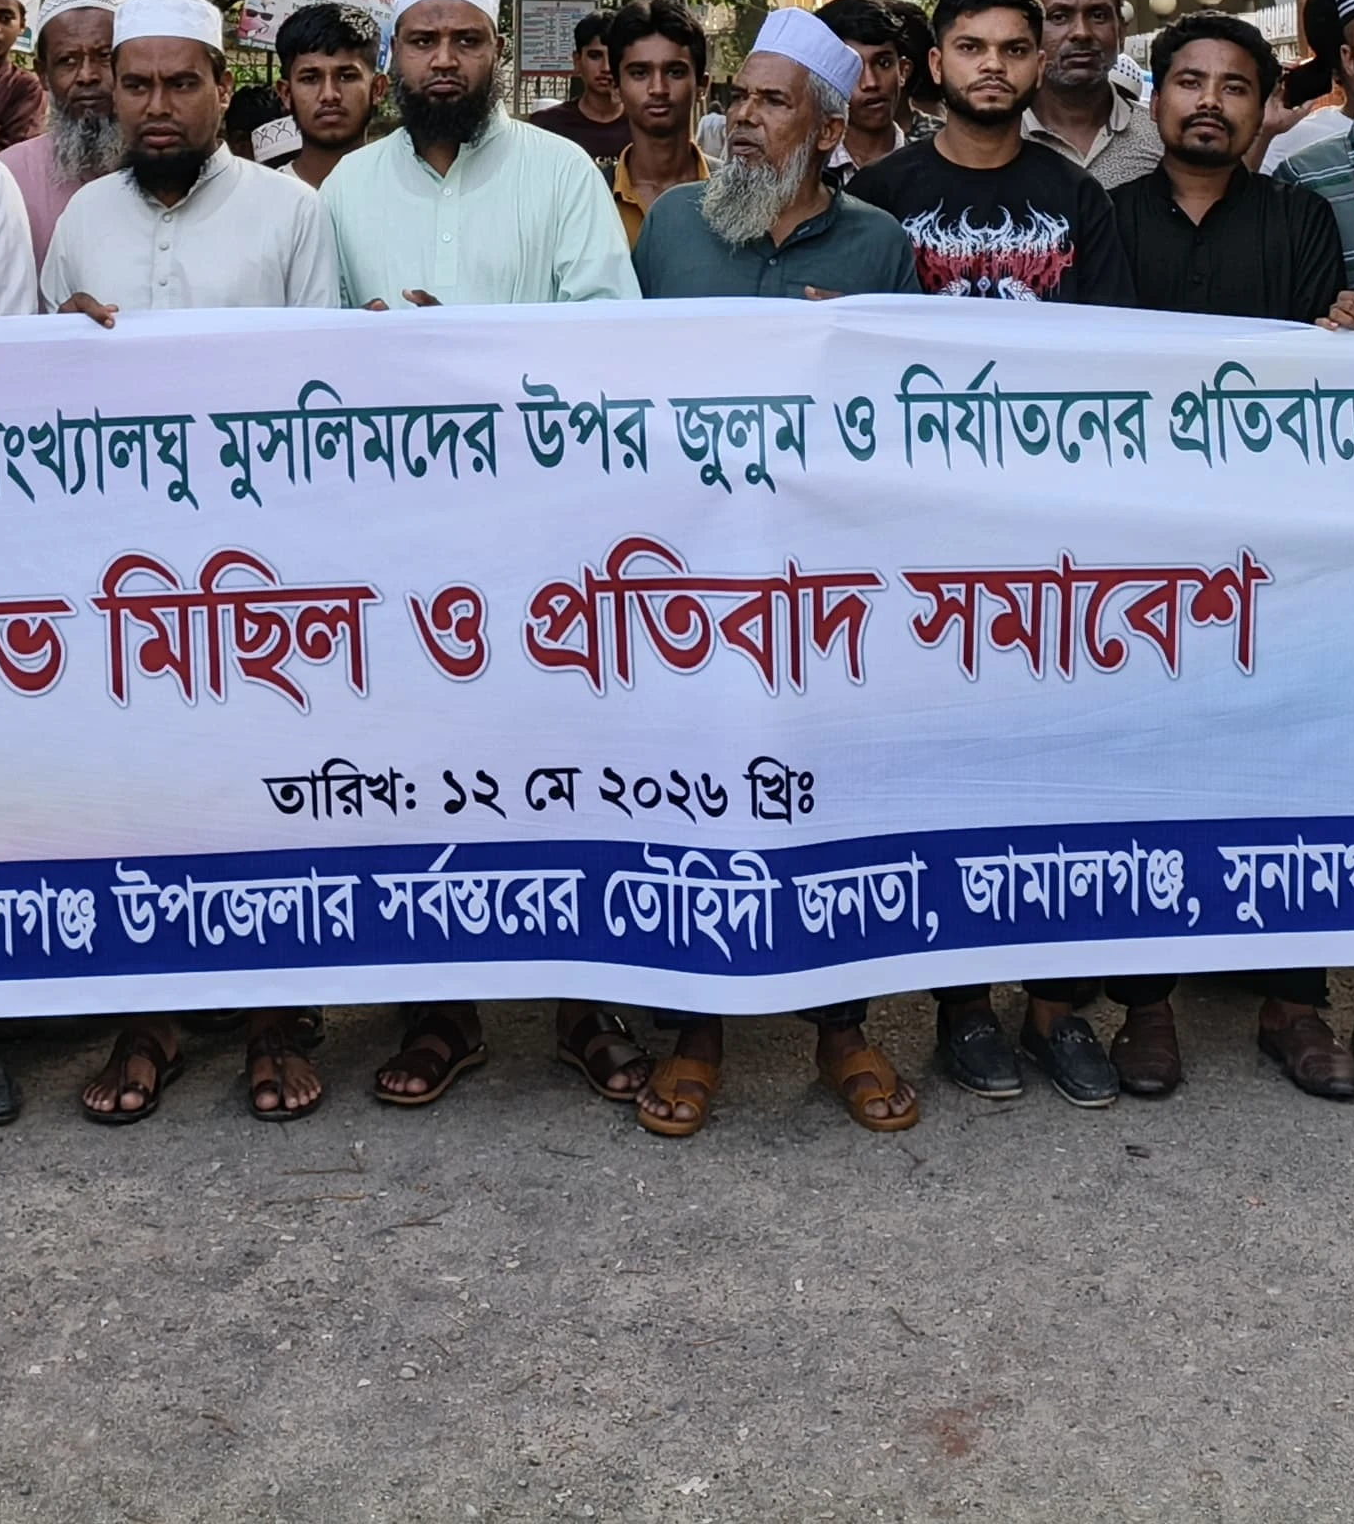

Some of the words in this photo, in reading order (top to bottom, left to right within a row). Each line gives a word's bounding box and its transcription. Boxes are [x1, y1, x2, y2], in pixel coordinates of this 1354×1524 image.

[209, 378, 502, 506] মুসলিমদের
[516, 372, 654, 475] উপর
[668, 393, 817, 494] জুলুম
[834, 398, 877, 463] ও
[895, 360, 1153, 470] নির্যাতনের
[88, 545, 384, 716] মিছিল
[406, 580, 490, 684] ও
[521, 533, 889, 698] প্রতিবাদ
[897, 546, 1274, 682] সমাবেশ
[443, 767, 506, 821] ১২
[524, 764, 583, 813] মে
[598, 770, 729, 825] ২০২৬
[743, 756, 817, 825] খ্রিঃ
[110, 861, 361, 950] উপজেলার
[371, 845, 586, 940] সর্বস্তরের
[602, 843, 782, 963] তৌহিদী
[792, 849, 939, 945] জনতা,
[954, 837, 1202, 929] জামালগঞ্জ,
